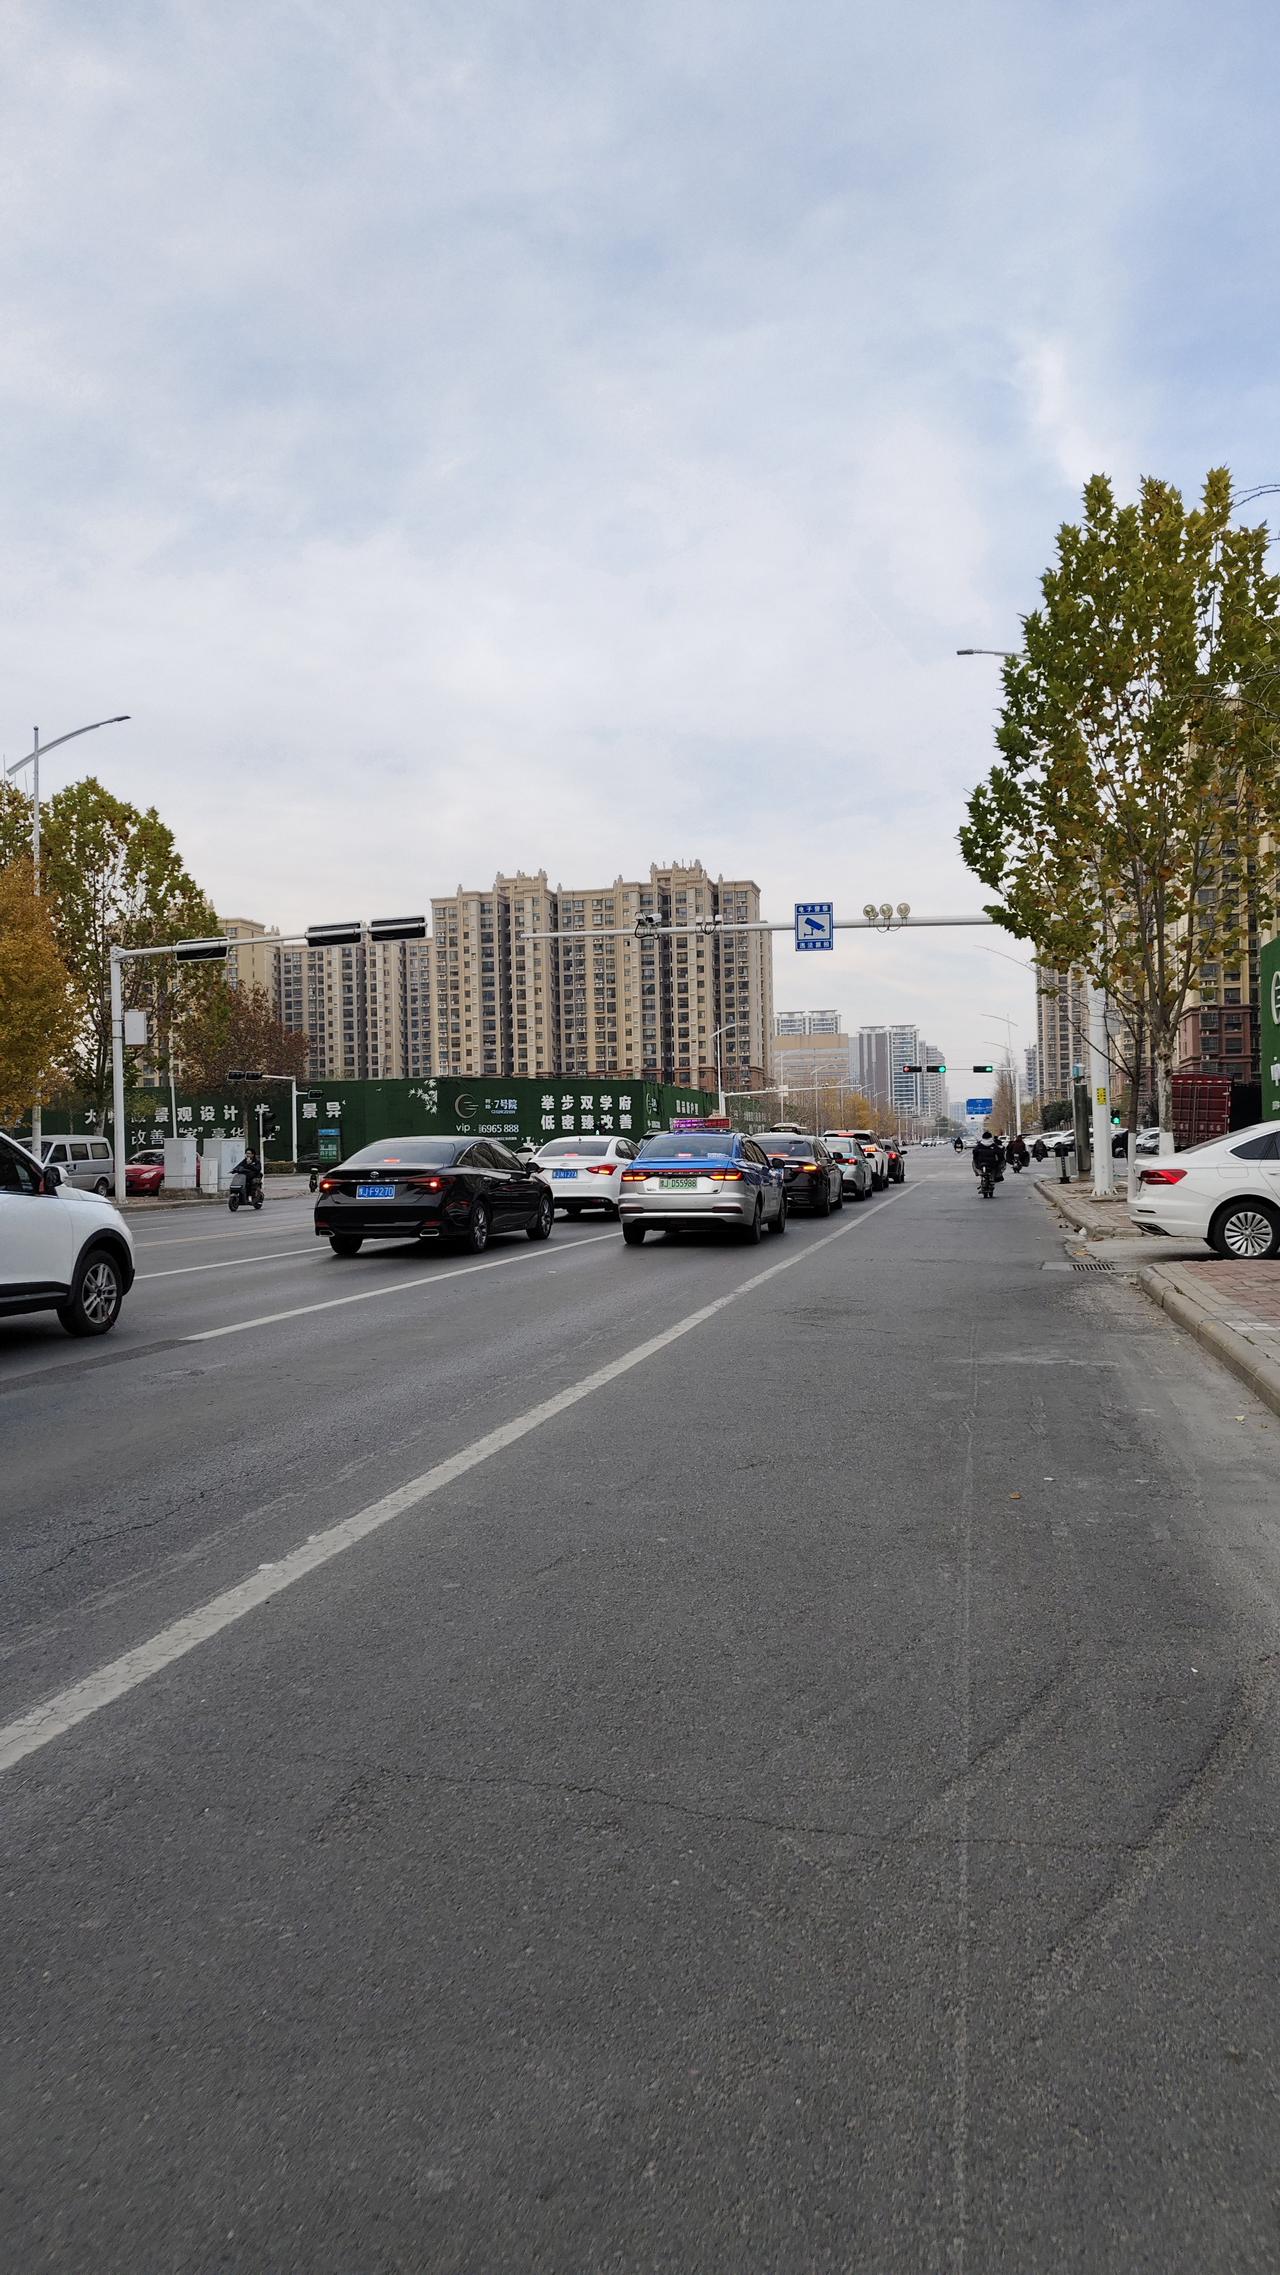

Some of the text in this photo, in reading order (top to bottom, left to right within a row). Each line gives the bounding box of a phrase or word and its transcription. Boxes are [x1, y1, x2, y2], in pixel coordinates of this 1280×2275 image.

[541, 1095, 632, 1110] 举步双学府
[84, 1104, 239, 1124] 大景观设计
[482, 1124, 502, 1133] 6965
[503, 1124, 519, 1133] 888
